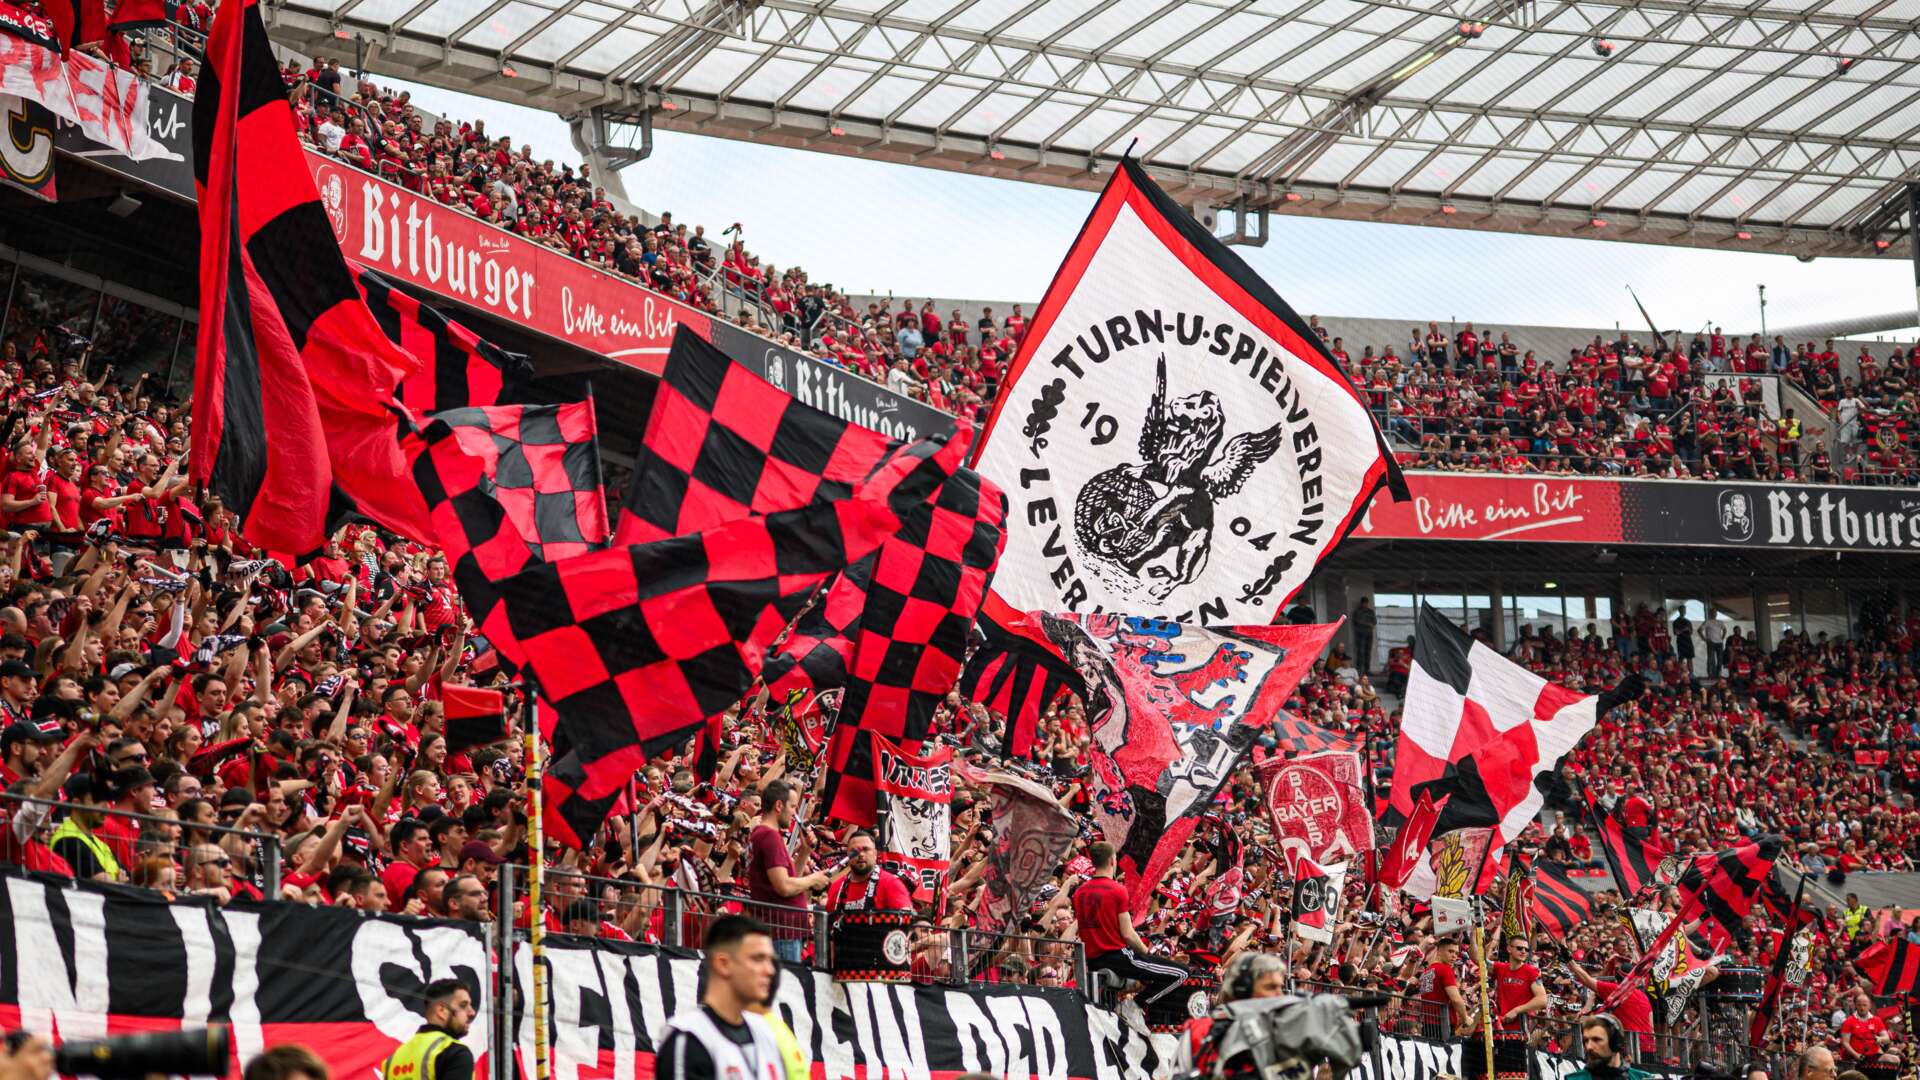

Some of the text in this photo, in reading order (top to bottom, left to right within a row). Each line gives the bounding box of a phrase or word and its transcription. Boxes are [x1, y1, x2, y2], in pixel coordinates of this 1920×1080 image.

[360, 180, 536, 319] Bitburger
[561, 286, 677, 340] Bitte ein Bit
[1415, 496, 1478, 534] Bitte
[1485, 499, 1530, 521] ein
[1533, 482, 1583, 515] Bit
[1275, 796, 1337, 822] BAYER
